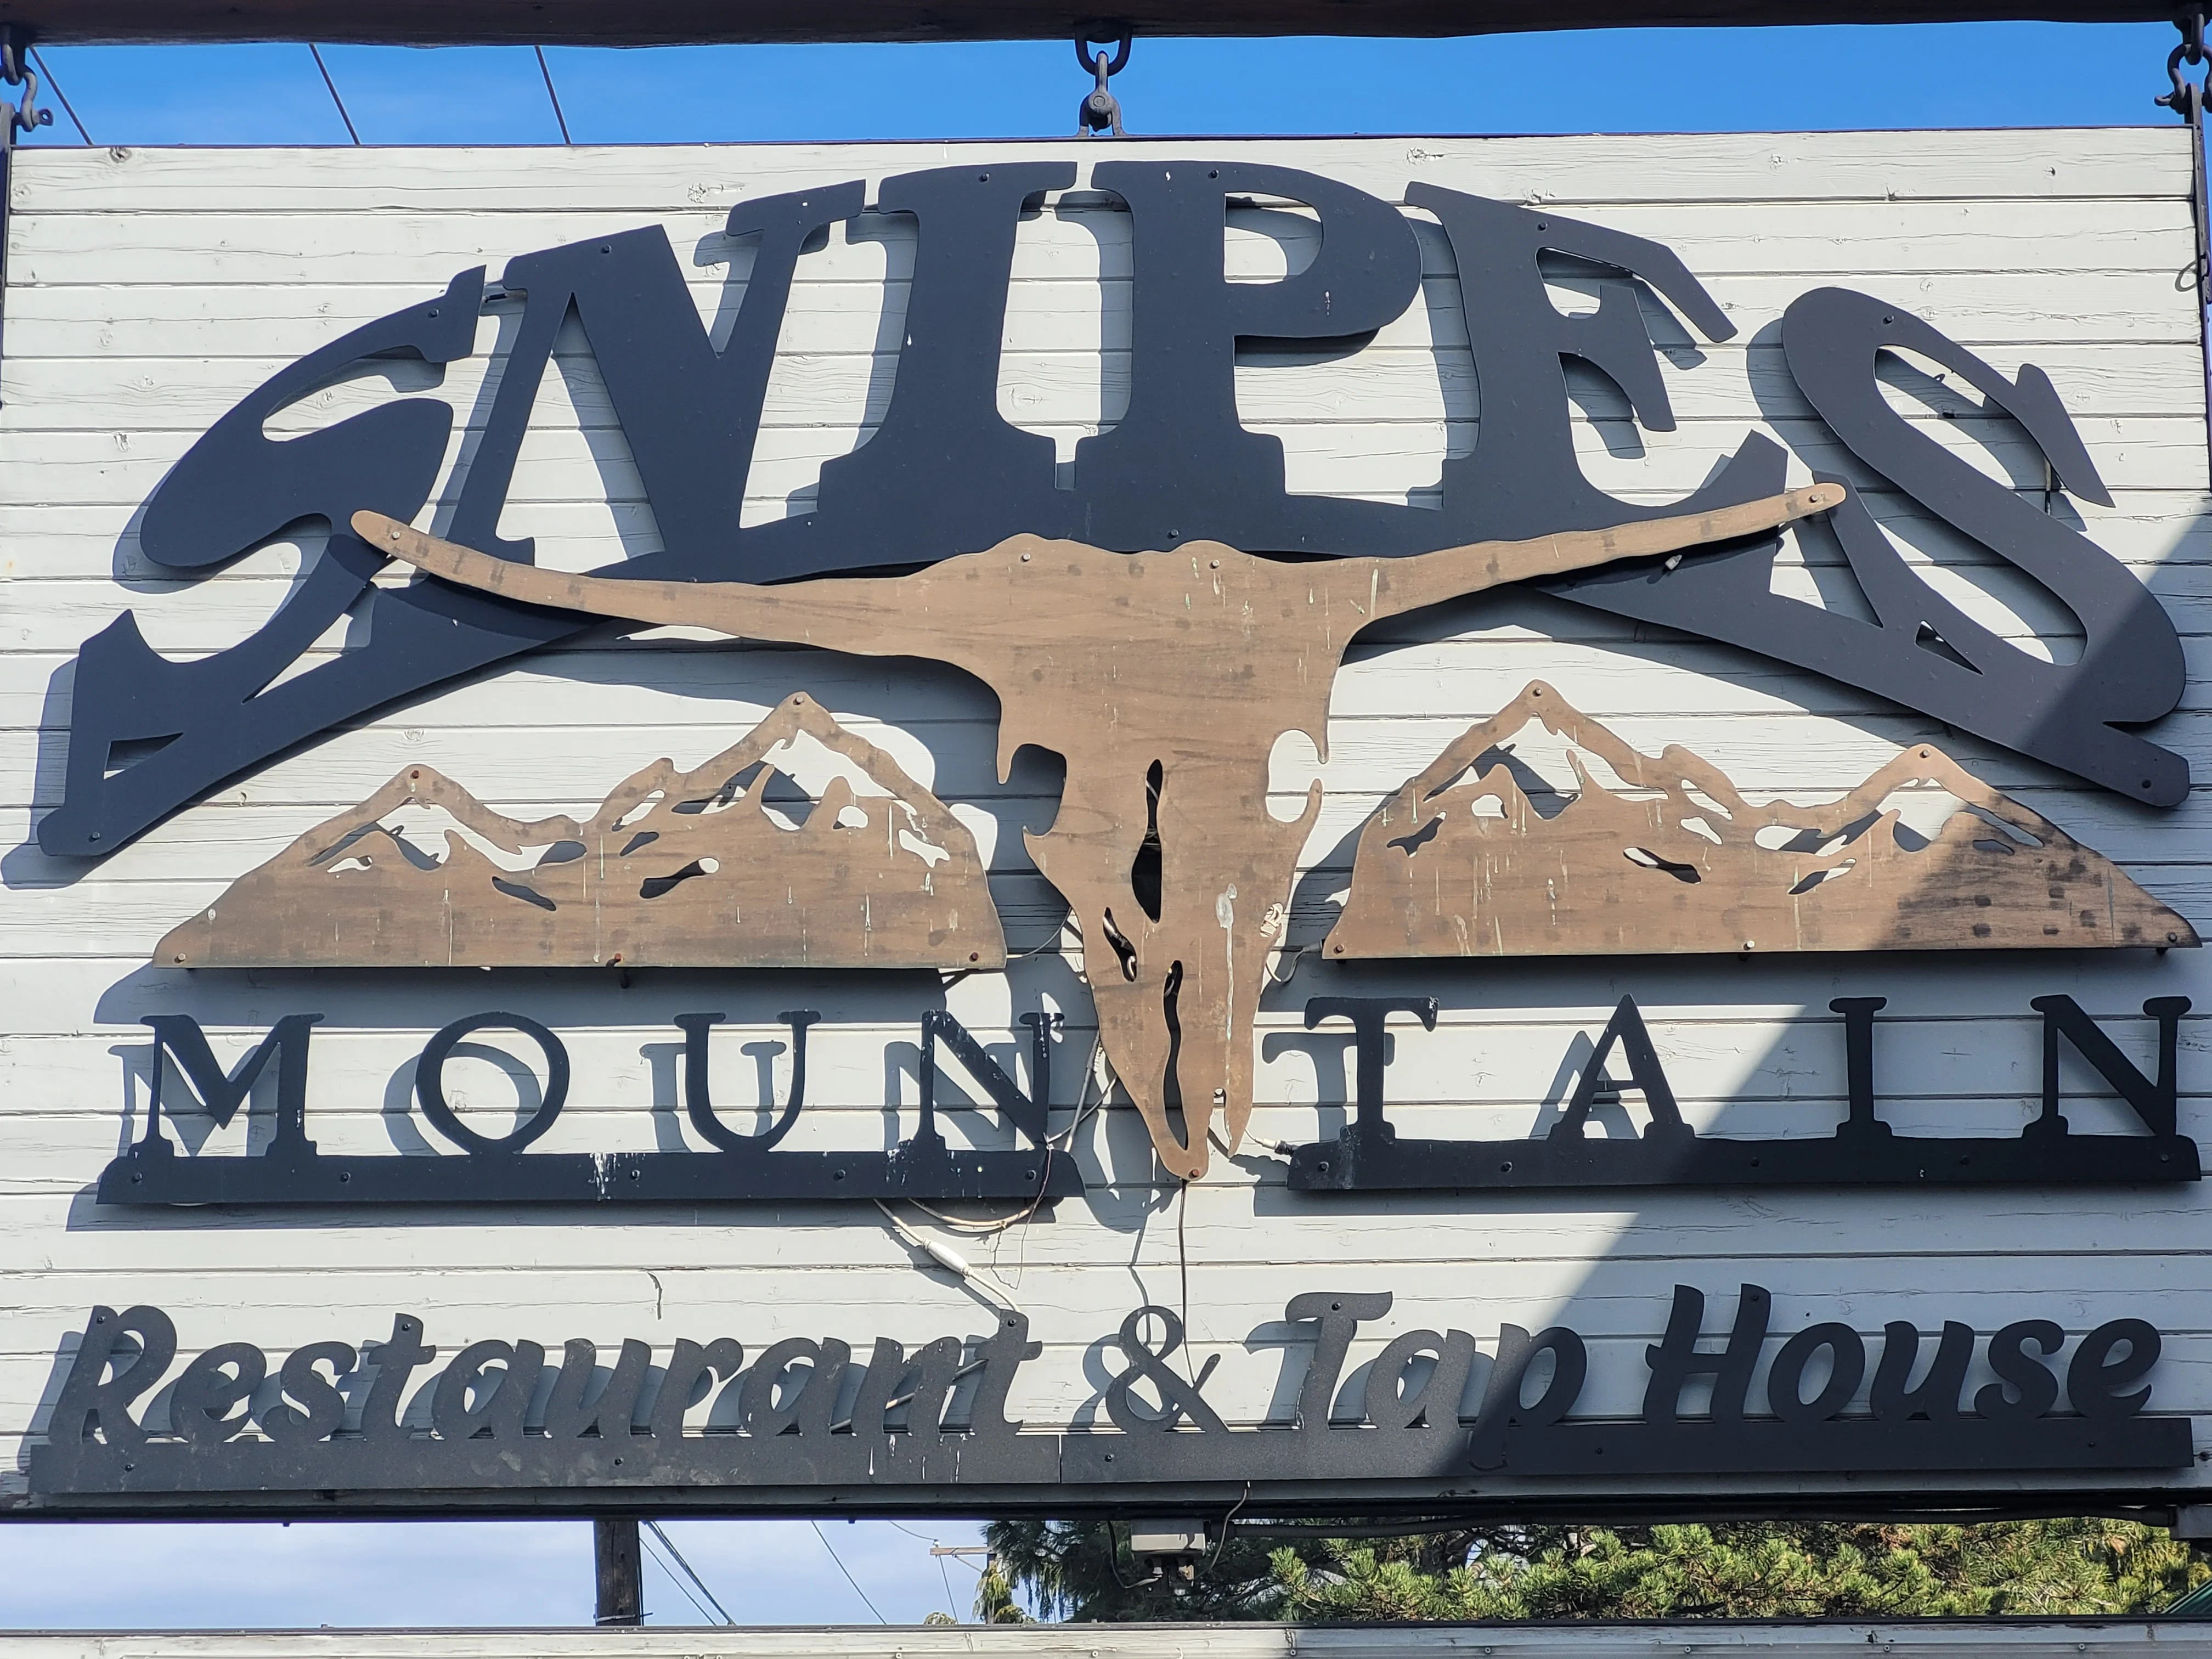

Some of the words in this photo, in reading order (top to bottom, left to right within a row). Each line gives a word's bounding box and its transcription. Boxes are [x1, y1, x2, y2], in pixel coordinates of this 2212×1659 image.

[36, 159, 2188, 859] SNIPES
[47, 1305, 1043, 1447] Restaurant
[1104, 1306, 1230, 1433] &
[1285, 1291, 1588, 1471] Tap
[1646, 1284, 2163, 1427] House
